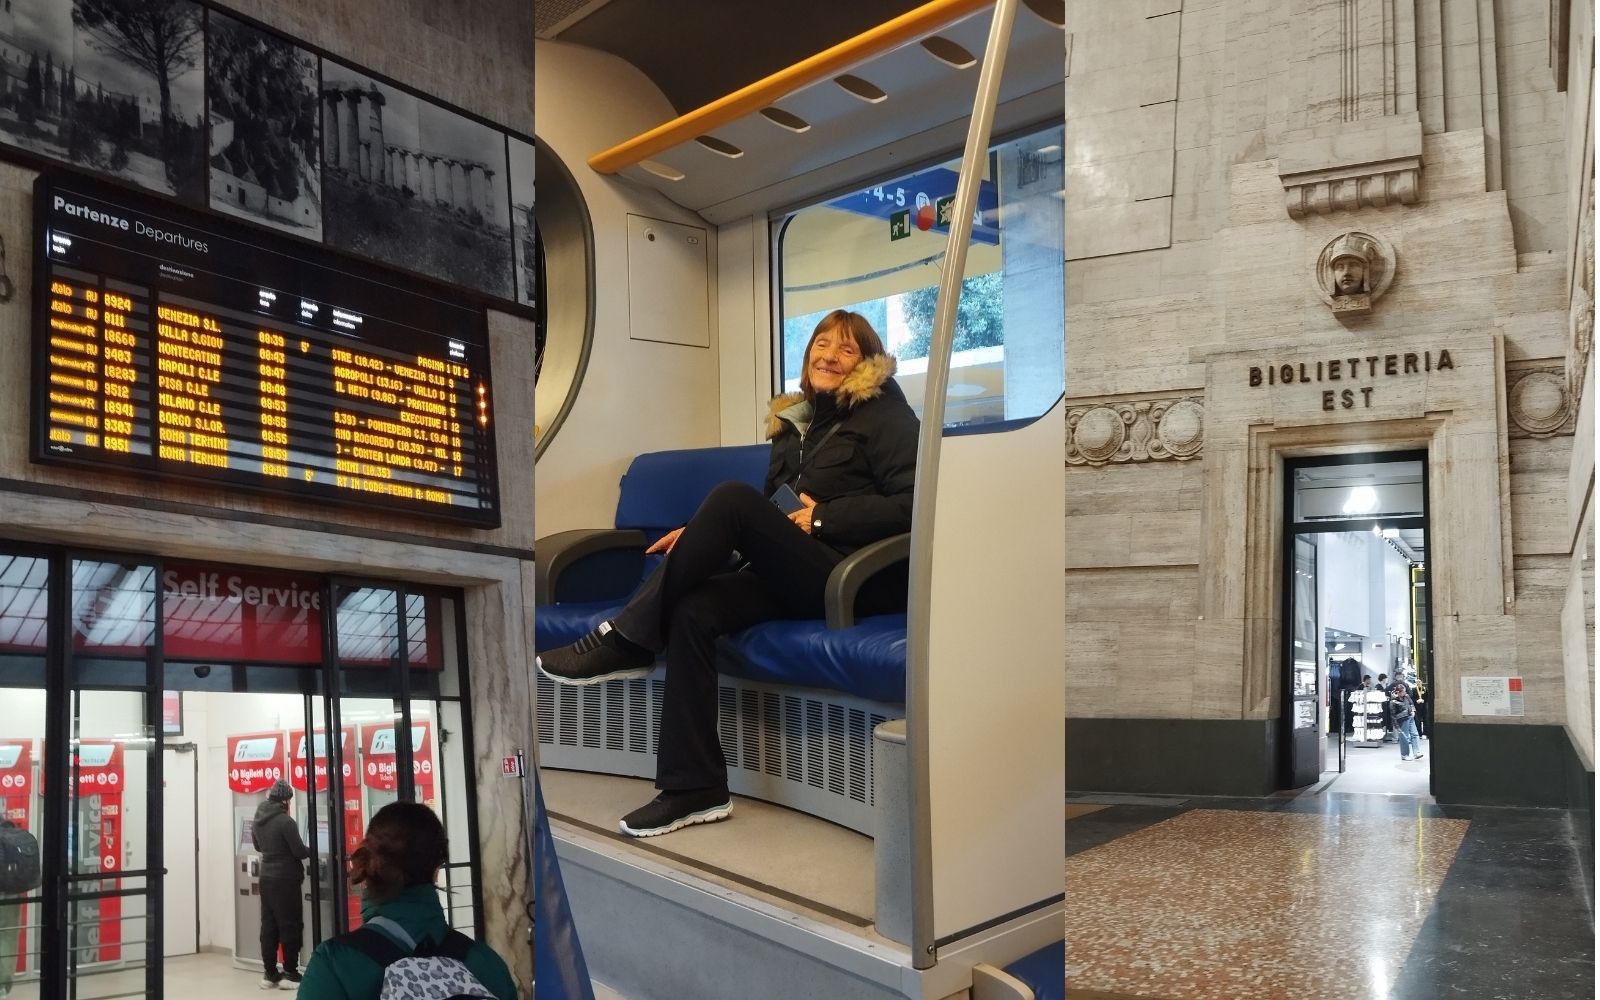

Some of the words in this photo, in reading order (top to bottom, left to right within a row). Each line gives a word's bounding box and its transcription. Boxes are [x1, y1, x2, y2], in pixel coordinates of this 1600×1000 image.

[54, 196, 129, 231] Partenze
[135, 220, 208, 253] Departures
[104, 293, 132, 312] 8924
[158, 306, 200, 328] VENEZIA
[203, 318, 222, 332] S.L.
[259, 332, 284, 347] 08:39
[394, 364, 426, 382] VENEZIA
[104, 312, 124, 328] 8111
[158, 324, 188, 342] VILLA
[260, 348, 284, 364] 08:43
[158, 340, 221, 366] MONTECATINI
[260, 364, 285, 380] 08:47
[418, 356, 444, 372] PAGINA
[464, 368, 469, 378] 2
[1250, 349, 1454, 387] BIGLIETTERIA
[104, 382, 129, 398] 9512
[158, 393, 194, 411] MILANO
[199, 401, 220, 416] C.LE
[261, 413, 286, 428] 08:55
[158, 376, 182, 392] PISA
[186, 382, 208, 396] C.LE
[260, 397, 286, 412] 08:53
[158, 358, 194, 378] NAPOLI
[199, 367, 220, 382] C.LE
[400, 411, 442, 429] EXECUTIVE
[451, 422, 460, 434] 12
[1322, 386, 1374, 411] EST
[104, 400, 134, 418] 18941
[158, 410, 192, 428] BORGO
[262, 430, 288, 444] 08:55
[454, 466, 462, 476] 17
[104, 436, 129, 452] 8951
[160, 446, 186, 461] ROMA
[190, 450, 228, 468] TERMINI
[160, 427, 186, 444] ROMA
[190, 432, 228, 450] TERMINI
[164, 570, 220, 602] Self
